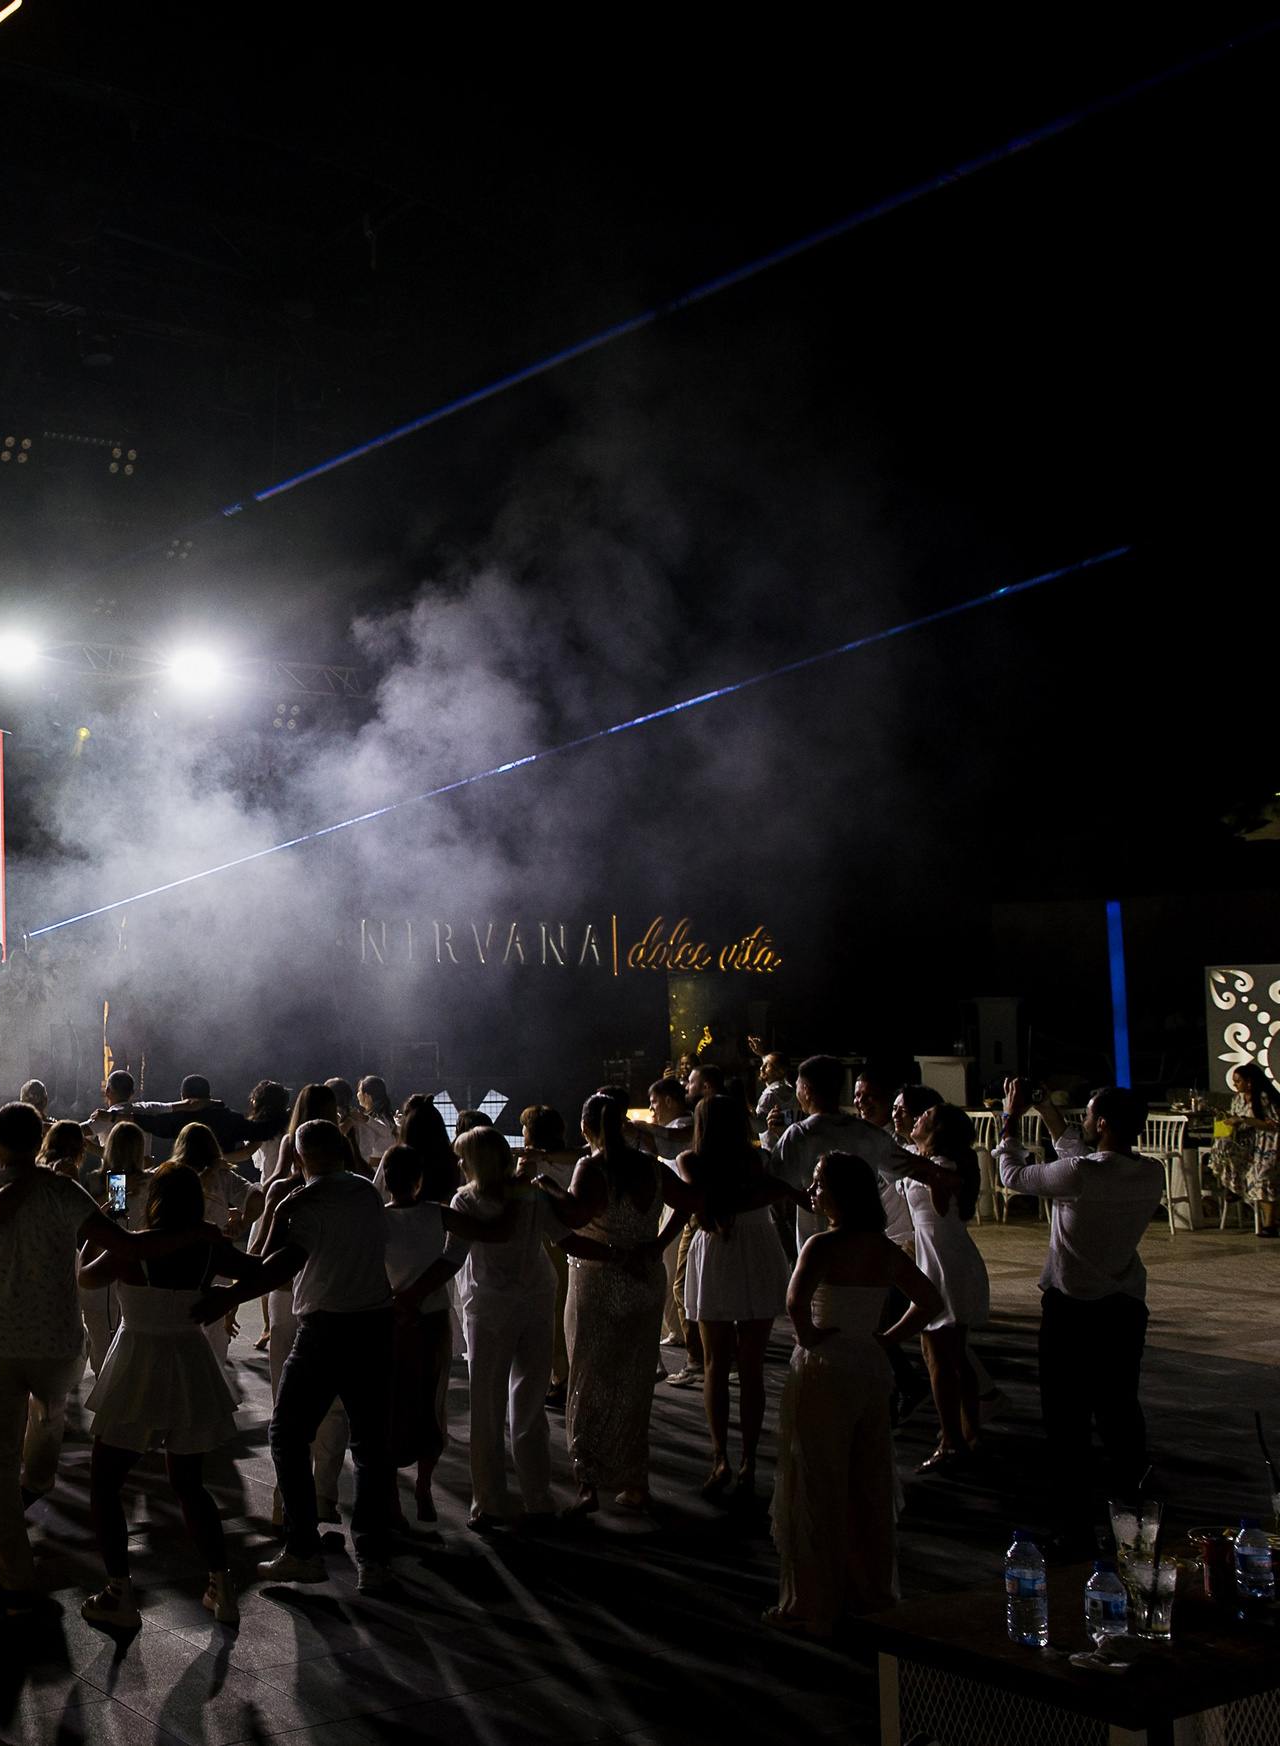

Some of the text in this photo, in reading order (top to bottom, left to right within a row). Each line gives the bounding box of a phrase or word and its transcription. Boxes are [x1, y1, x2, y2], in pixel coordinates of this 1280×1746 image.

[360, 915, 782, 973] NIRVANA dolce vita
